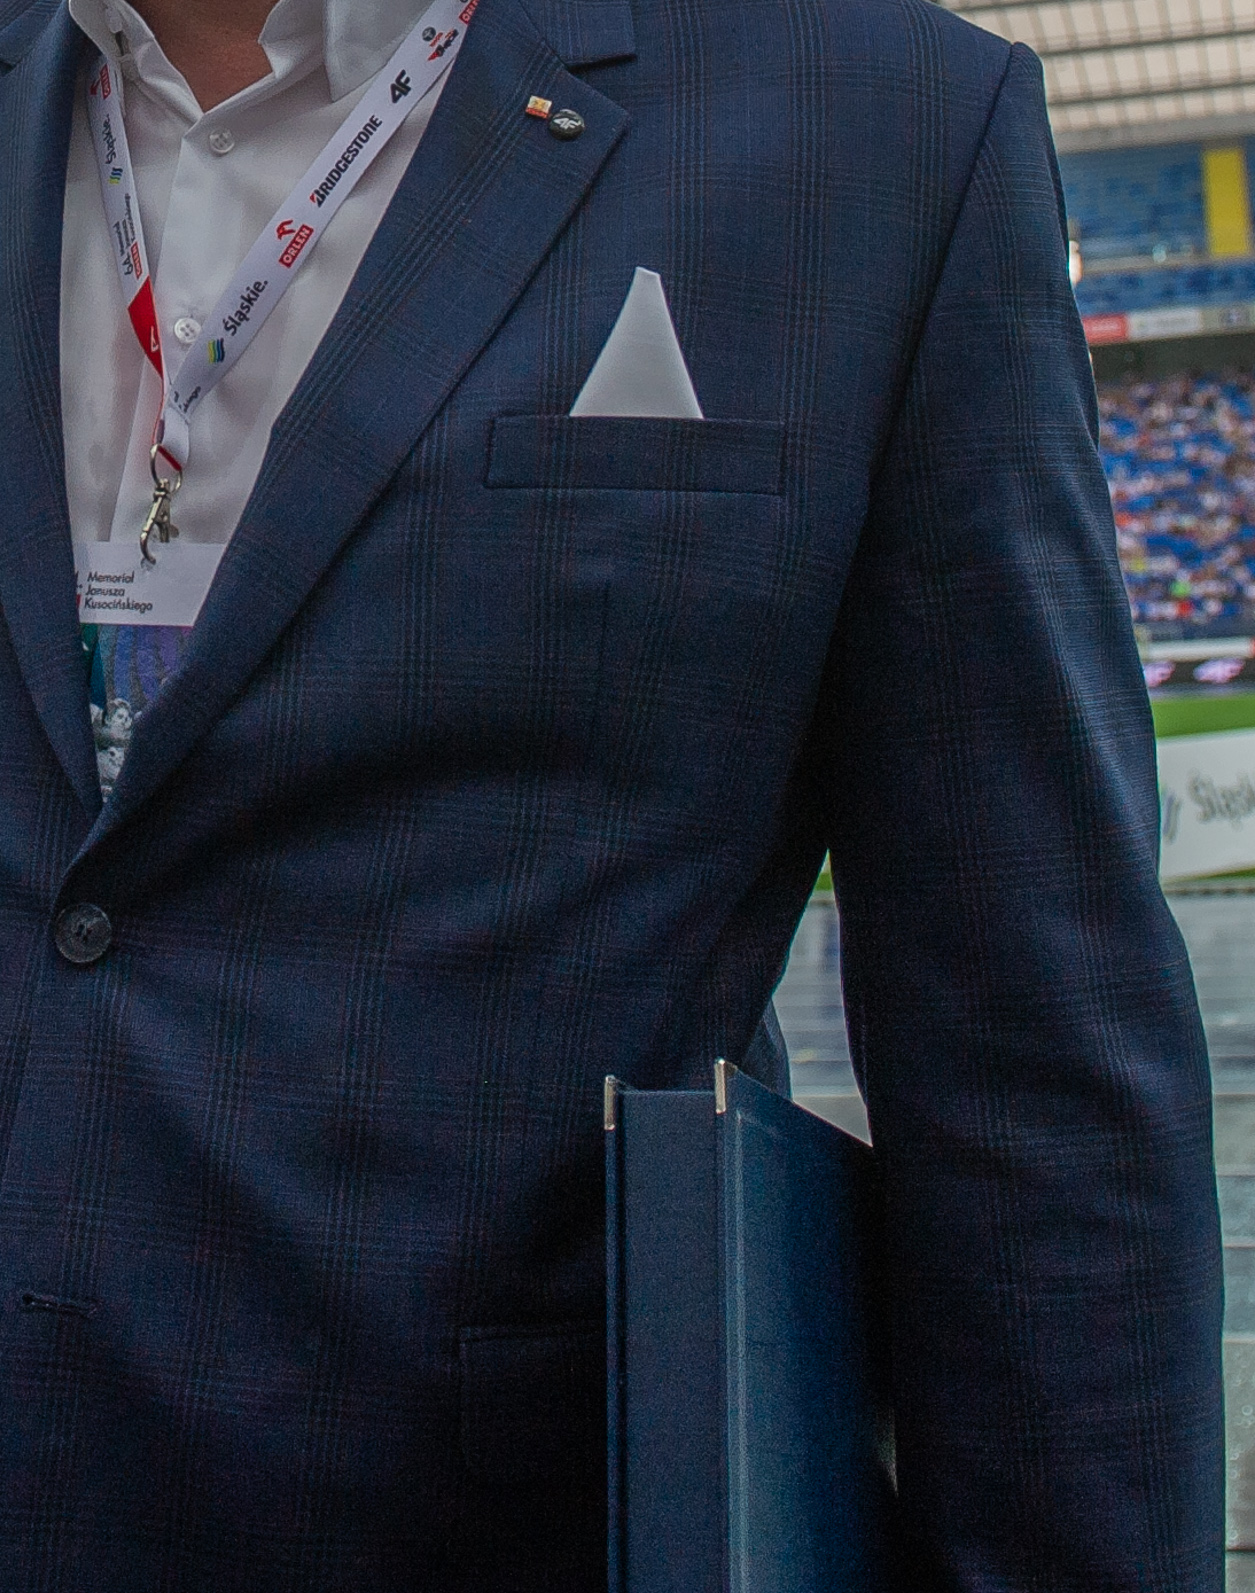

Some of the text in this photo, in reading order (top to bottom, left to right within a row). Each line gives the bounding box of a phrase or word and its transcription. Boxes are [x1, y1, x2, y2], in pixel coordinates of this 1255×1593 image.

[390, 69, 411, 103] 4F
[553, 117, 579, 130] 4F
[310, 115, 382, 207] BRIDGESTONE
[282, 225, 311, 264] ORLEN
[223, 279, 268, 336] Śląskie.
[84, 597, 153, 614] Kusocińskiego
